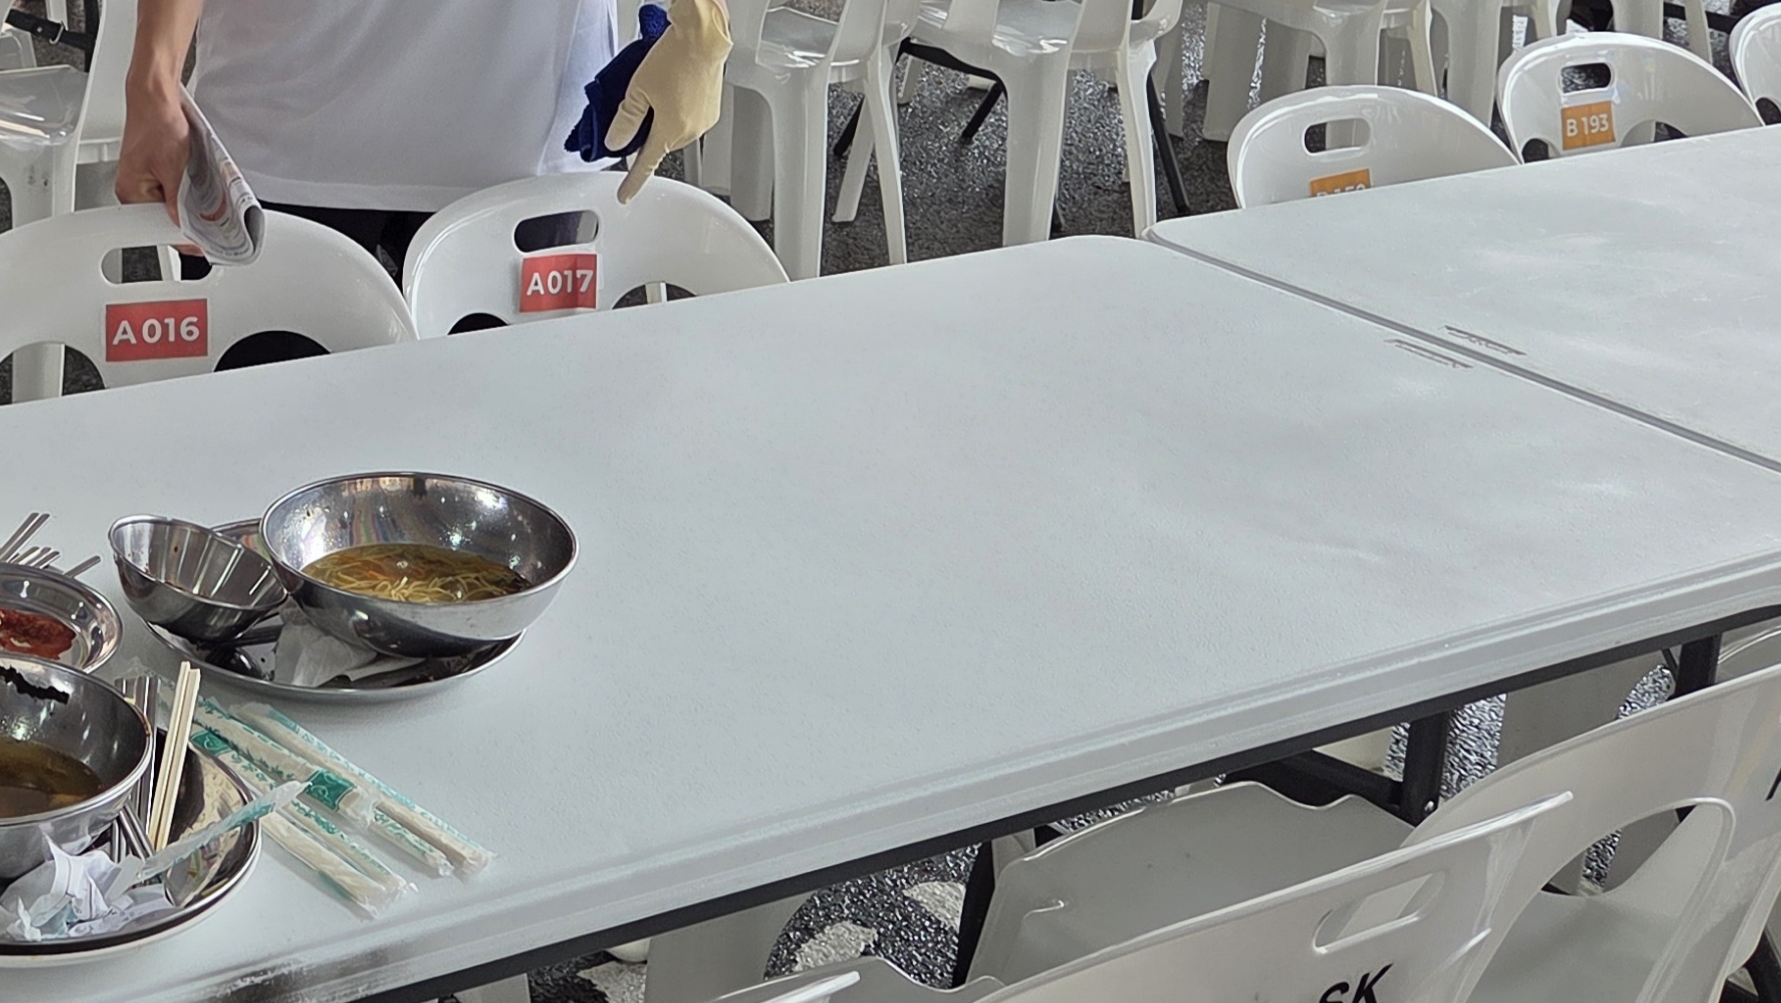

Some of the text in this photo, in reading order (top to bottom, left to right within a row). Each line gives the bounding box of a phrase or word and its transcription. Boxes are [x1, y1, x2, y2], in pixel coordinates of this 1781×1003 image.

[1566, 113, 1610, 137] B 193
[526, 269, 594, 296] A017
[112, 316, 199, 346] A016
